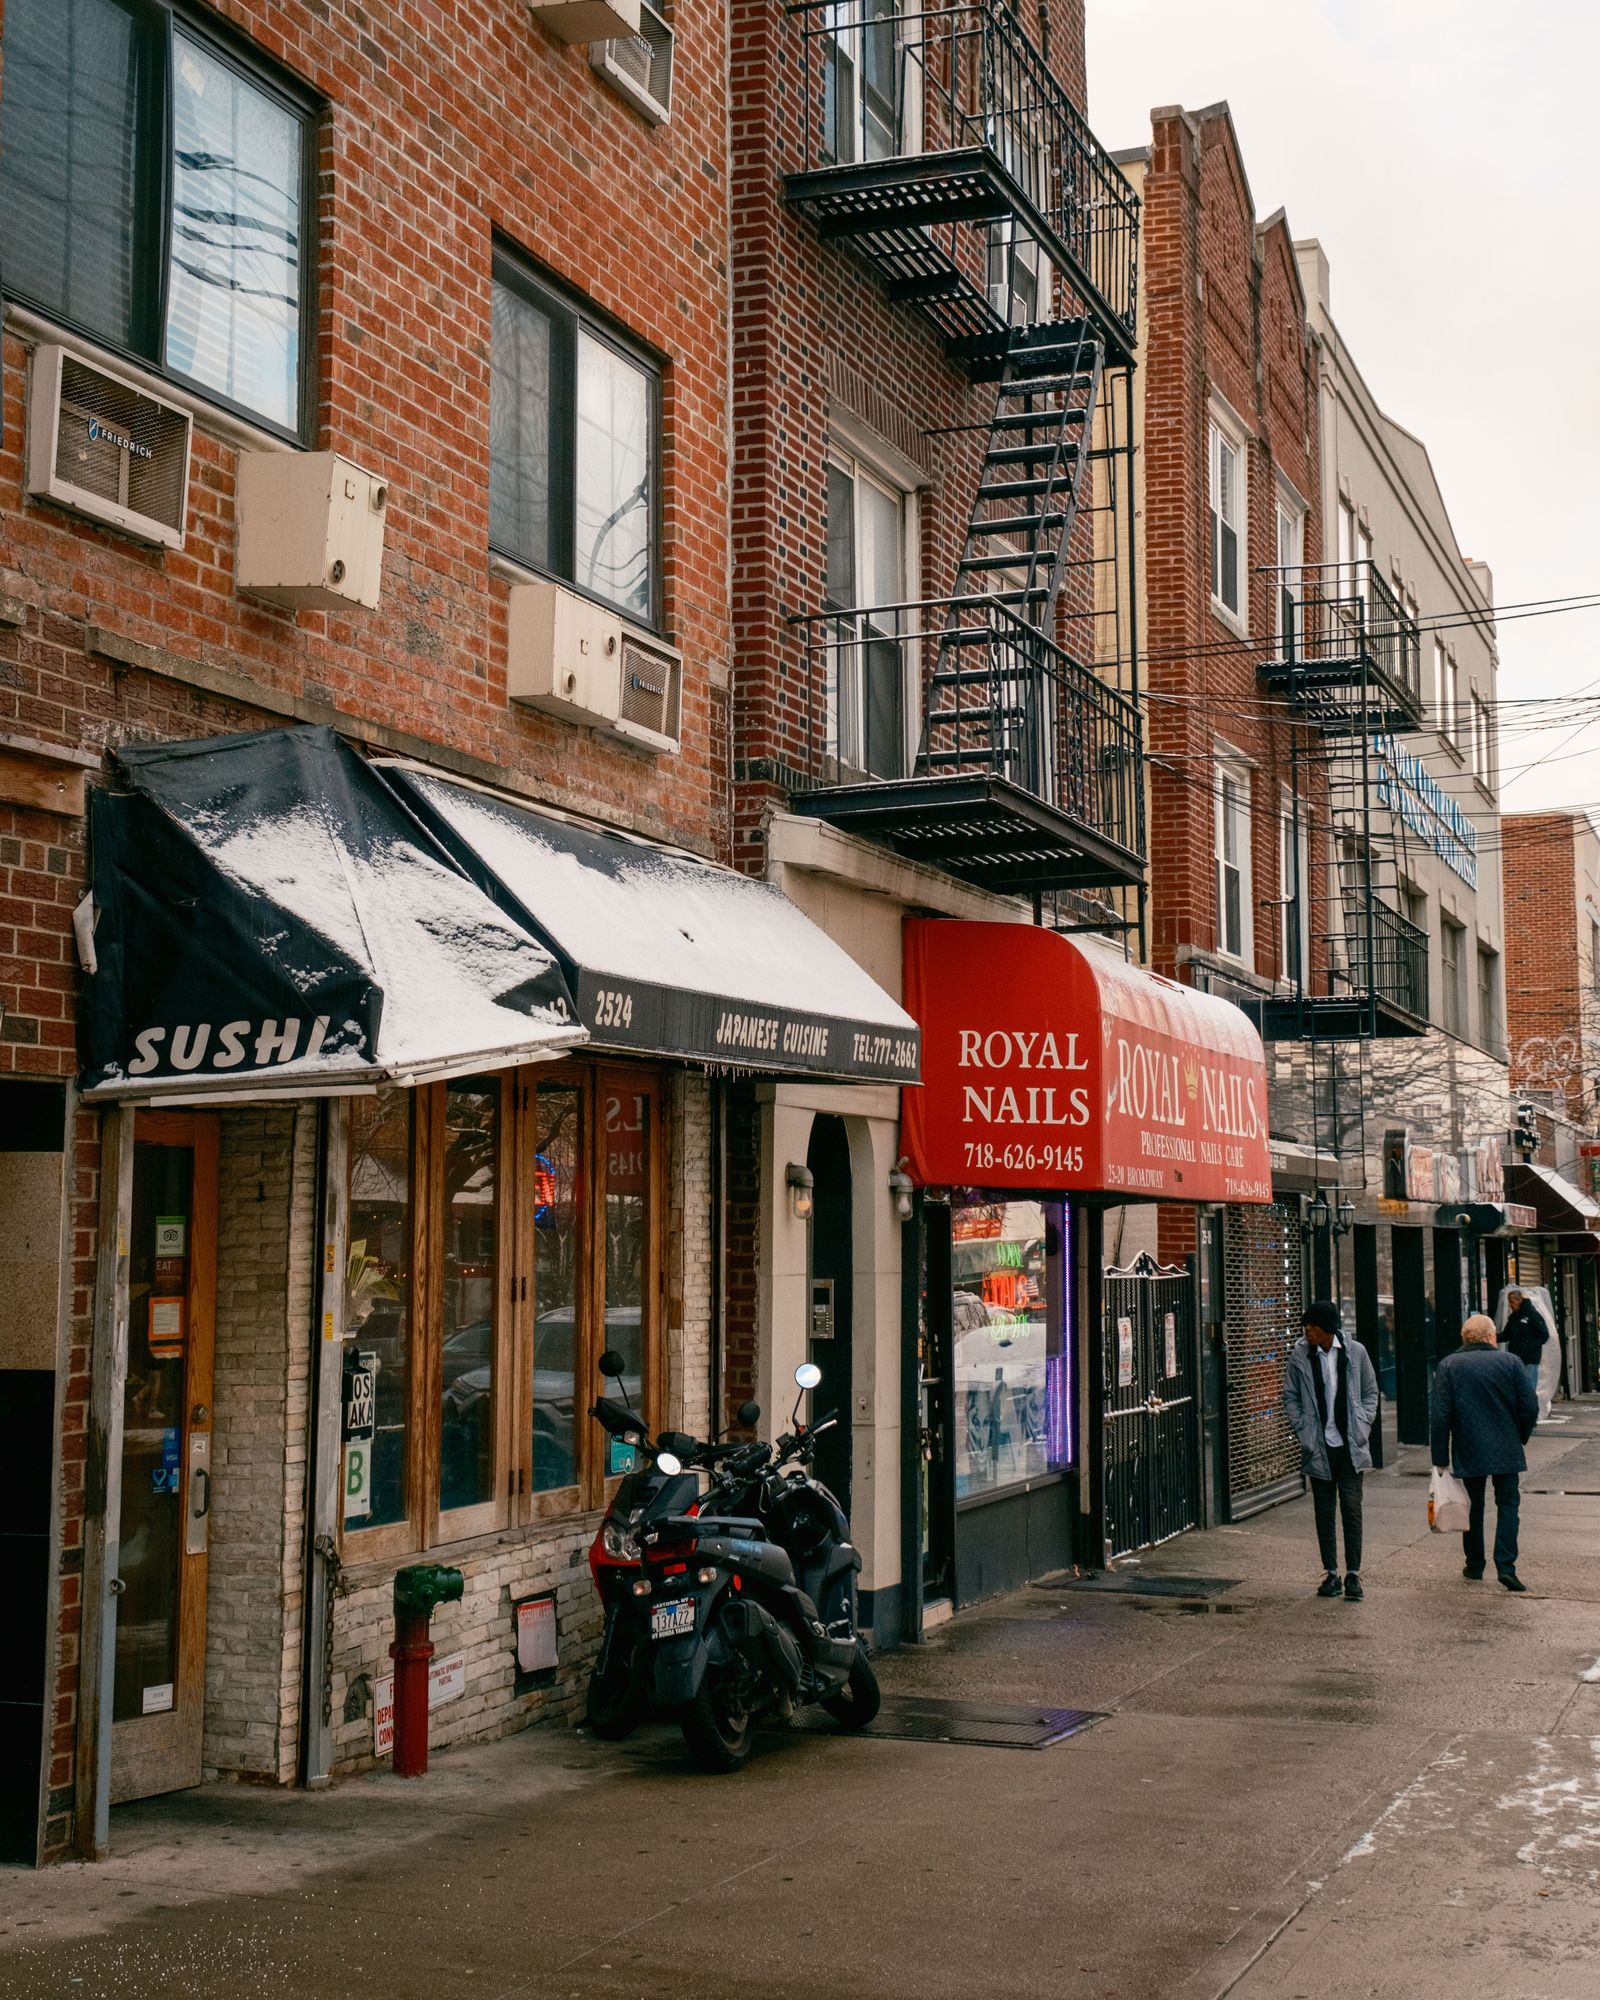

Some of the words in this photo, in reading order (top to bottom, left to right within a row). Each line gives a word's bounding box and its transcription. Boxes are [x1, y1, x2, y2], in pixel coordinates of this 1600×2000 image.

[101, 429, 152, 459] FRIEDRICH
[127, 1015, 331, 1075] SUSHI
[594, 990, 633, 1029] 2524
[716, 1012, 779, 1050] JAPANESE
[783, 1022, 829, 1057] CUISINE
[853, 1033, 917, 1069] TEL:777-2662
[958, 1030, 1089, 1070] ROYAL
[962, 1086, 1090, 1126] NAILS
[1117, 1038, 1186, 1127] ROYAL
[1201, 1065, 1257, 1140] NAILS
[964, 1143, 1084, 1172] 718-626-9145
[1141, 1130, 1196, 1163] PROFESSIONAL
[1200, 1141, 1222, 1165] NAILS
[1225, 1144, 1245, 1168] CARE
[1127, 1166, 1164, 1189] BROADWAY
[1225, 1178, 1269, 1199] 718-626-9145
[354, 1374, 370, 1400] OS
[349, 1401, 373, 1428] AKA
[347, 1450, 363, 1496] B
